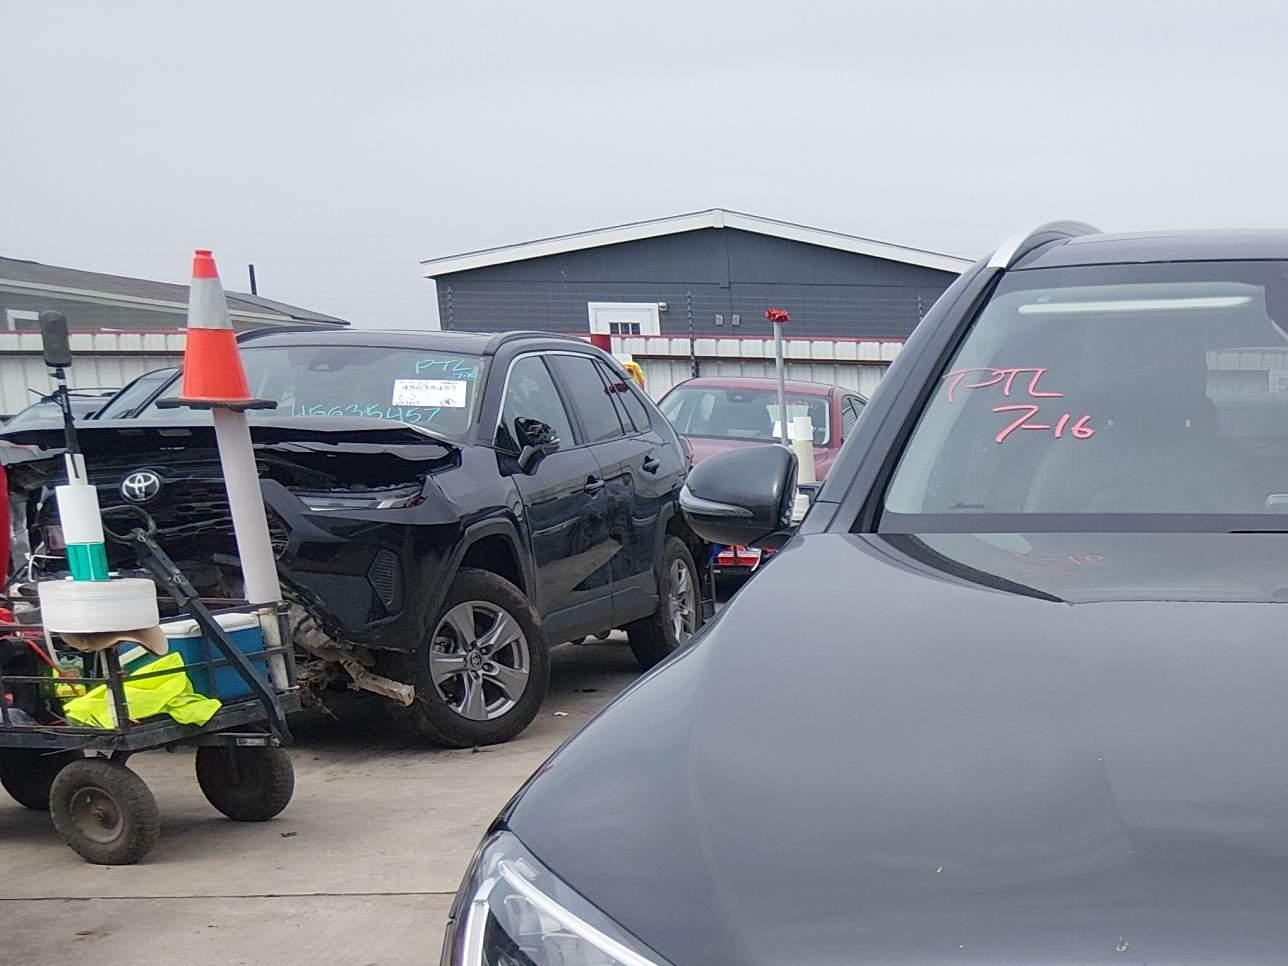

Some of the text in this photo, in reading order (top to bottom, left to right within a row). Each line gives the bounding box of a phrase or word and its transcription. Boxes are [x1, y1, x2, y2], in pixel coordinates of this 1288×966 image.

[414, 359, 473, 375] PTL
[942, 367, 1064, 402] PTL
[992, 404, 1095, 443] 7-16
